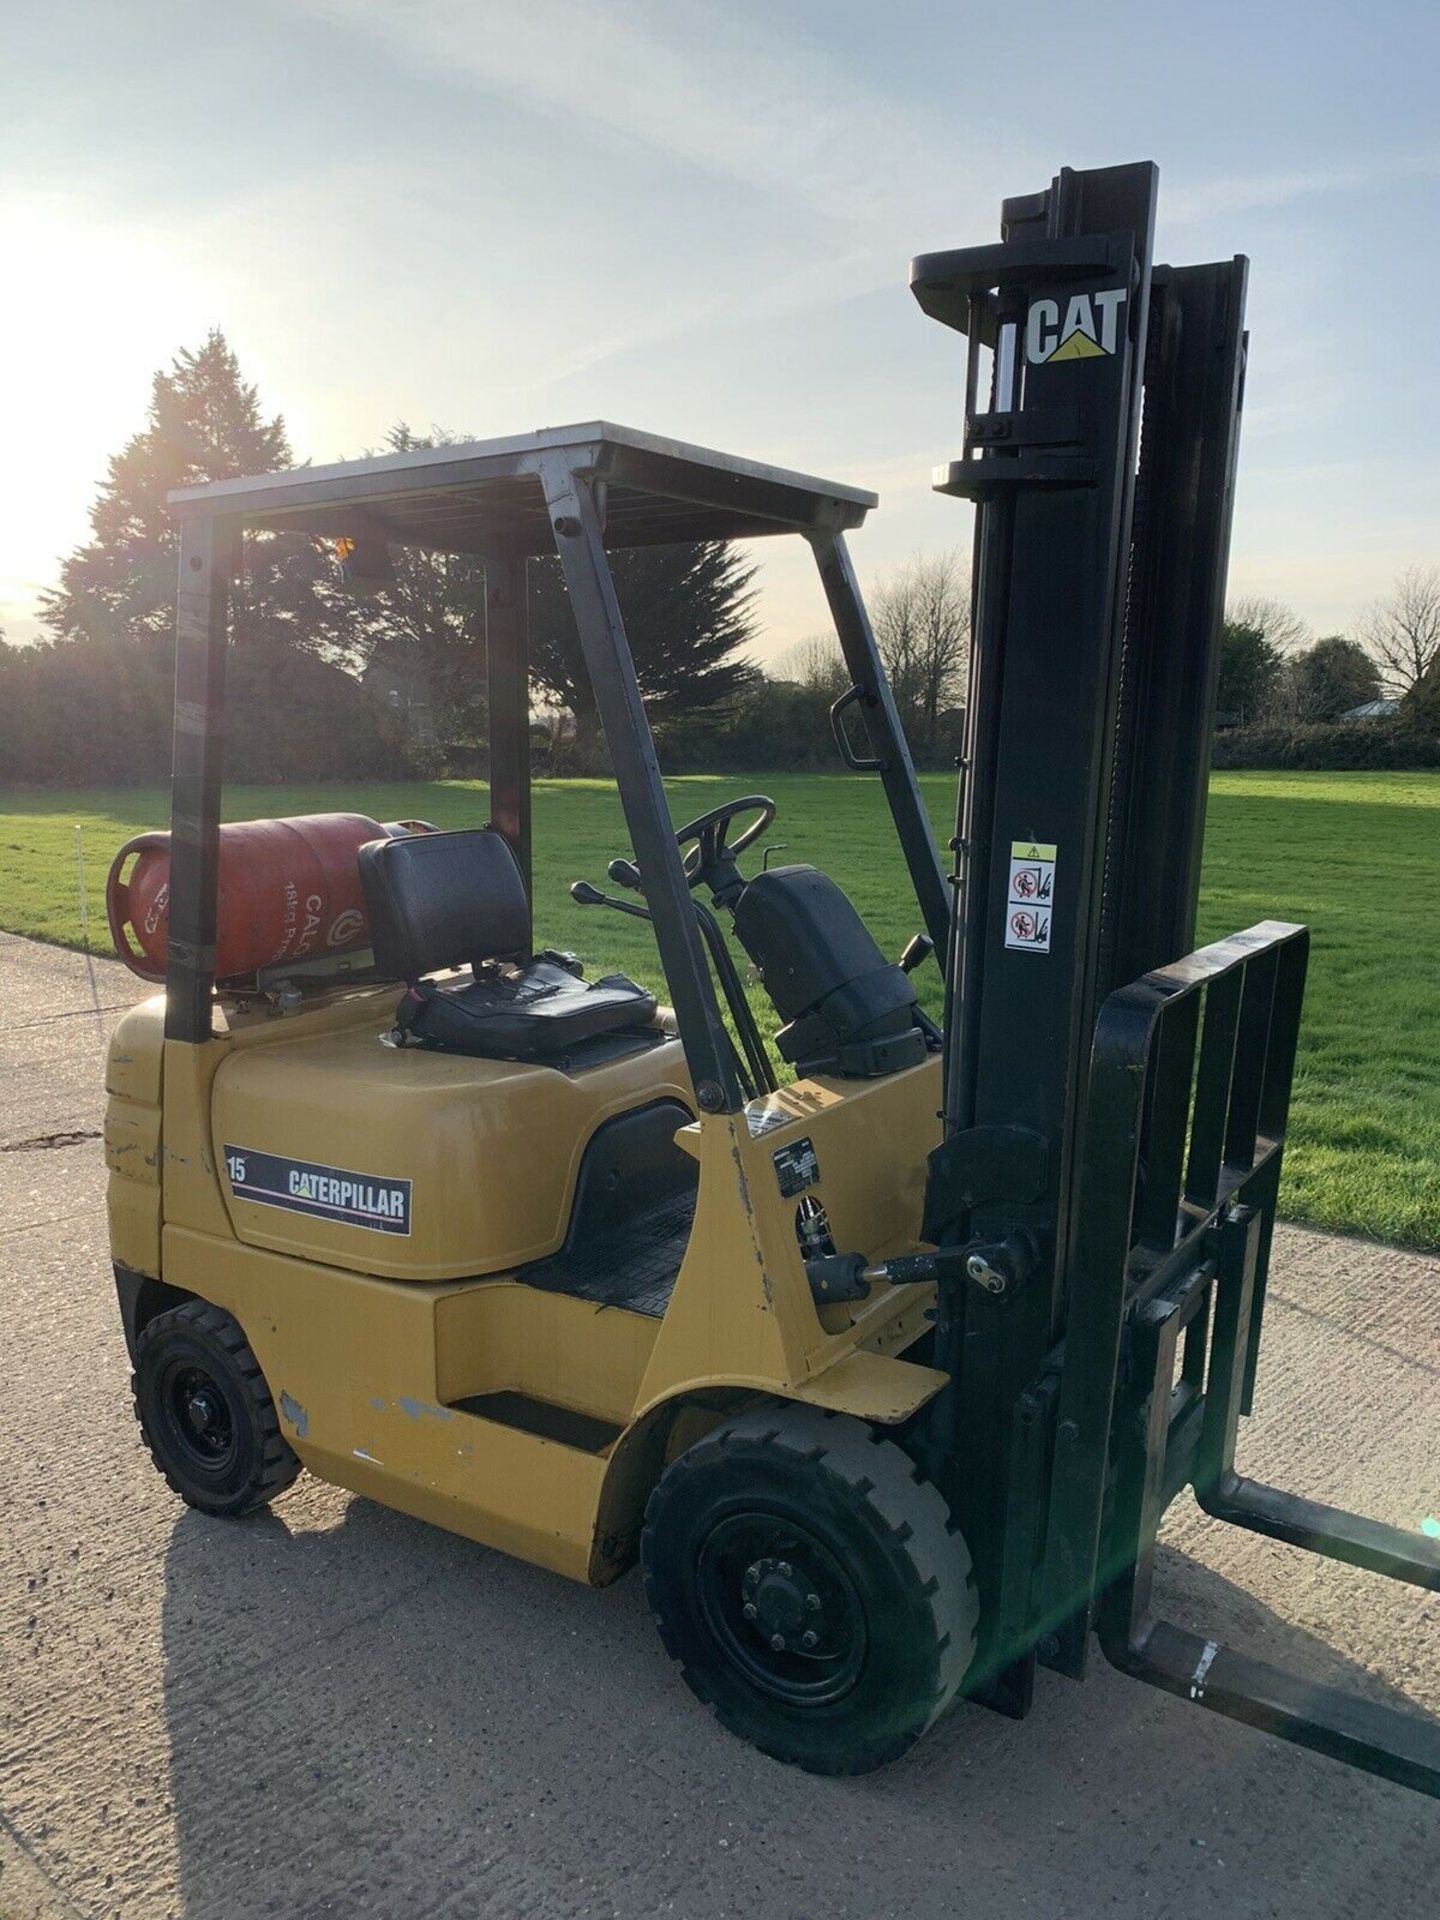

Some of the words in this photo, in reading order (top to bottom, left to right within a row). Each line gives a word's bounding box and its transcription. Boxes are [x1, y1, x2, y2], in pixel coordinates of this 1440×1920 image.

[1026, 288, 1127, 364] CAT
[227, 1156, 246, 1182] 15
[288, 1170, 404, 1217] CATERPILLAR
